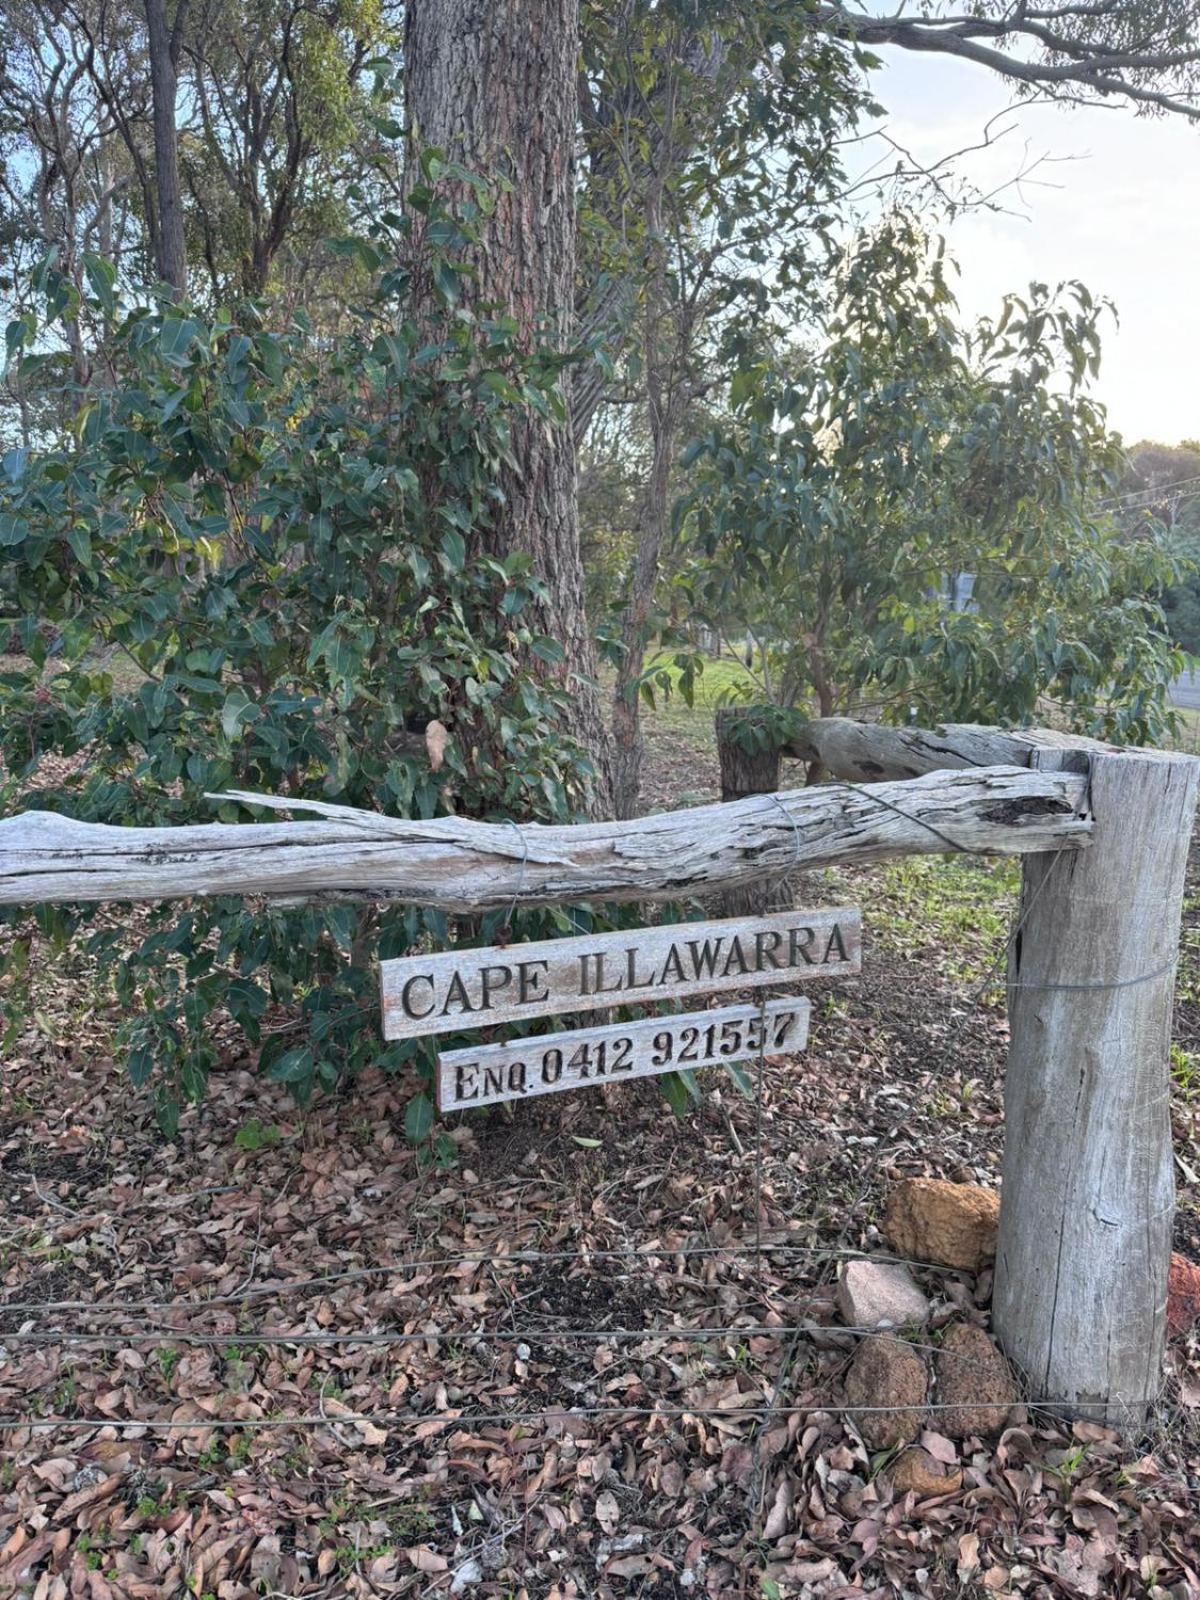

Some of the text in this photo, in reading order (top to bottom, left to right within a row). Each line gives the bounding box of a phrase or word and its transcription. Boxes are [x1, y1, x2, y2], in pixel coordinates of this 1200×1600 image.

[402, 922, 850, 1020] CAPE ILLAWARRA
[651, 1011, 796, 1067] 921557
